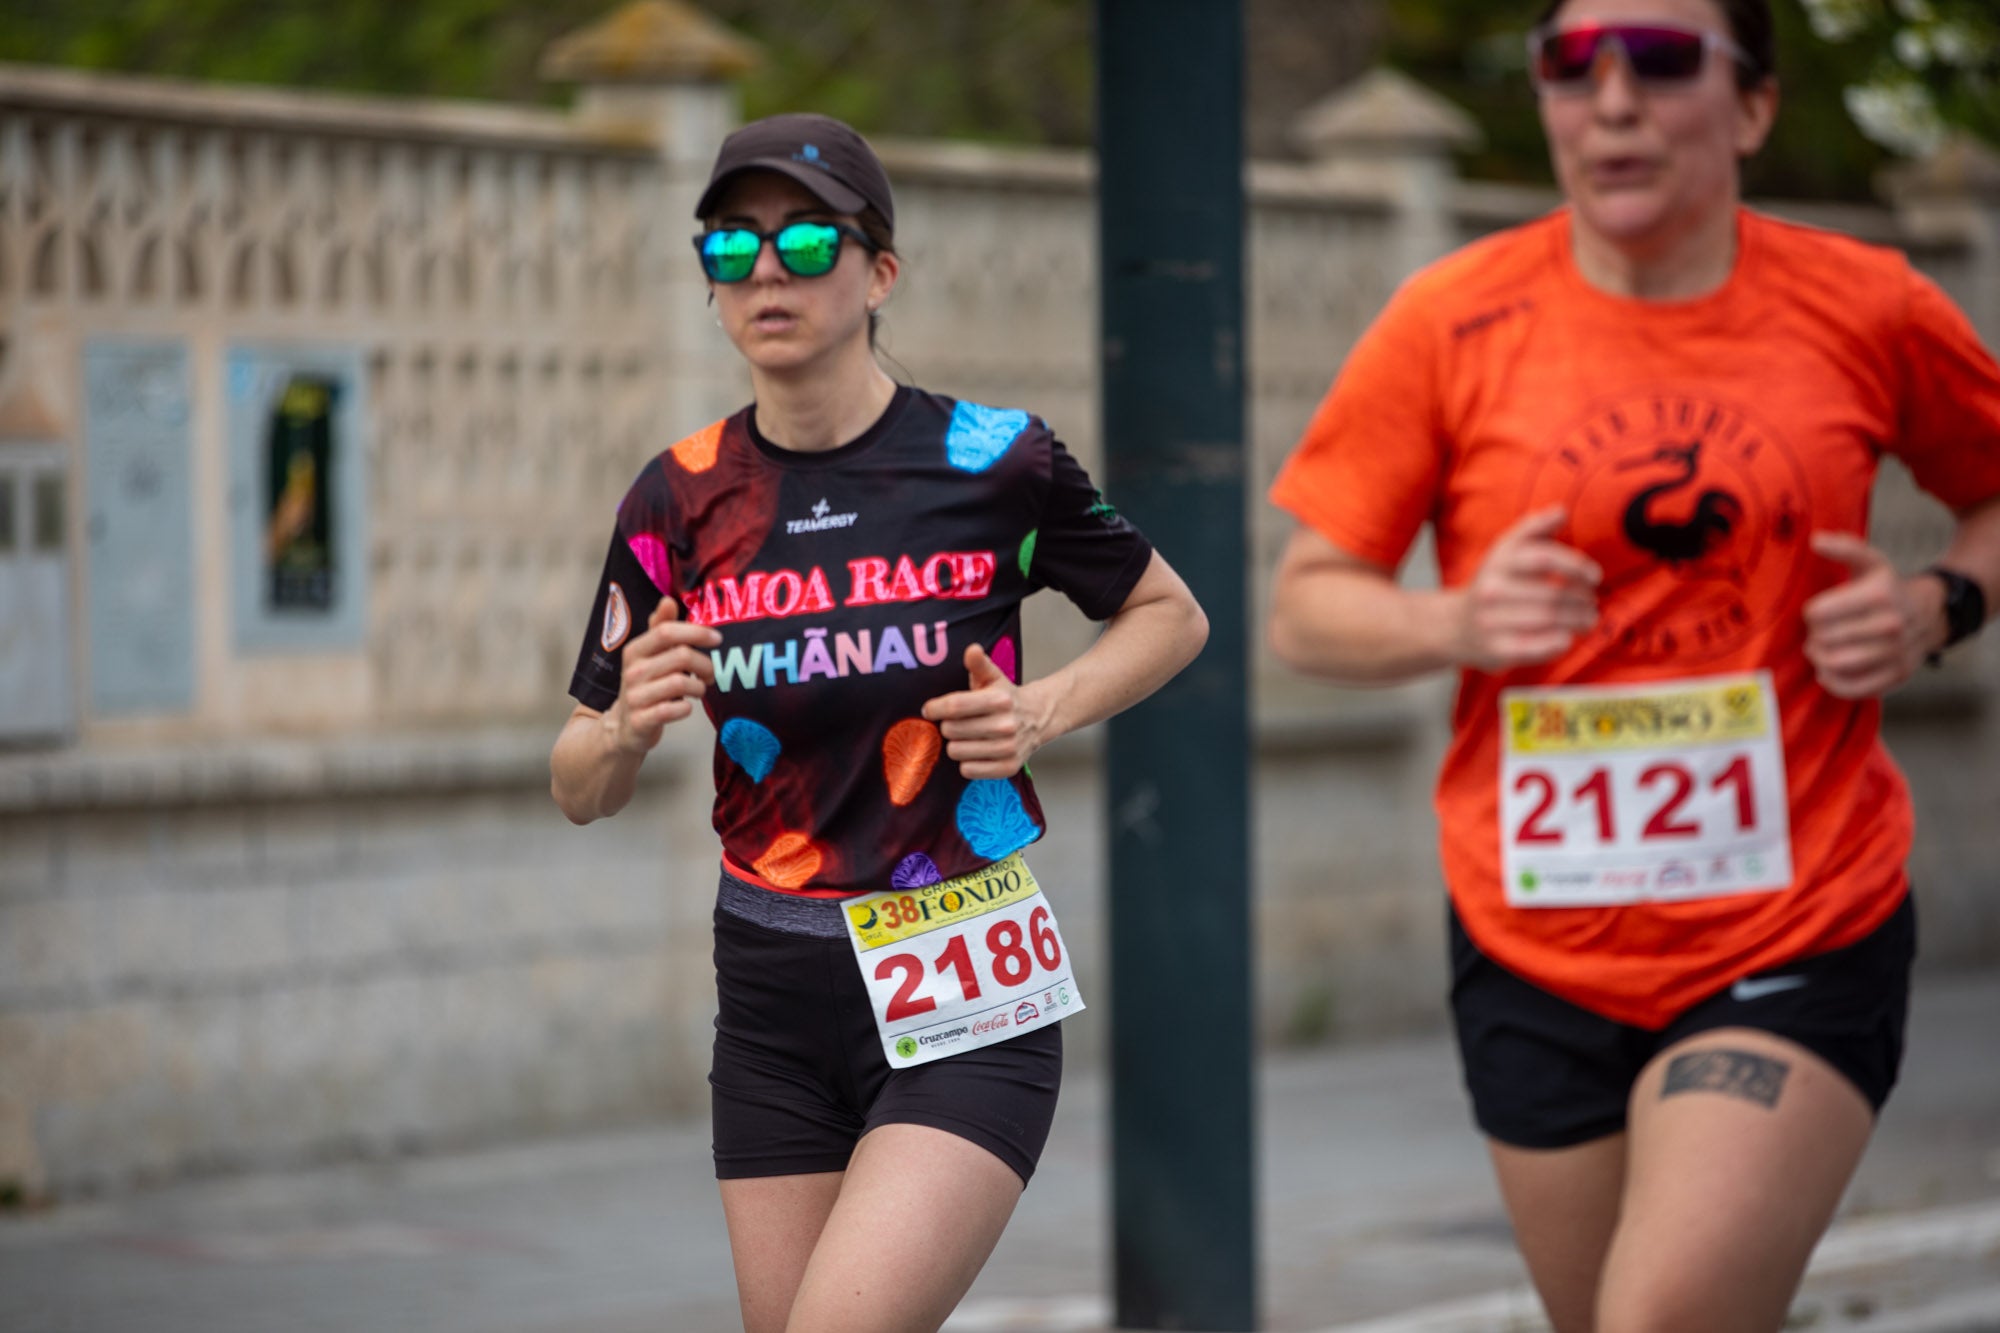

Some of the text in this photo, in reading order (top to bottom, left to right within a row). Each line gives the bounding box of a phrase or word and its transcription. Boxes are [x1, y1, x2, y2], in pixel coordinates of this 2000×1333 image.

[786, 512, 858, 535] TEAMERGY
[844, 550, 995, 607] RACE
[1512, 752, 1758, 846] 2121
[880, 895, 921, 930] 38
[918, 869, 1022, 921] FONDO
[873, 905, 1062, 1023] 2186
[918, 1025, 969, 1046] Cruzcampo
